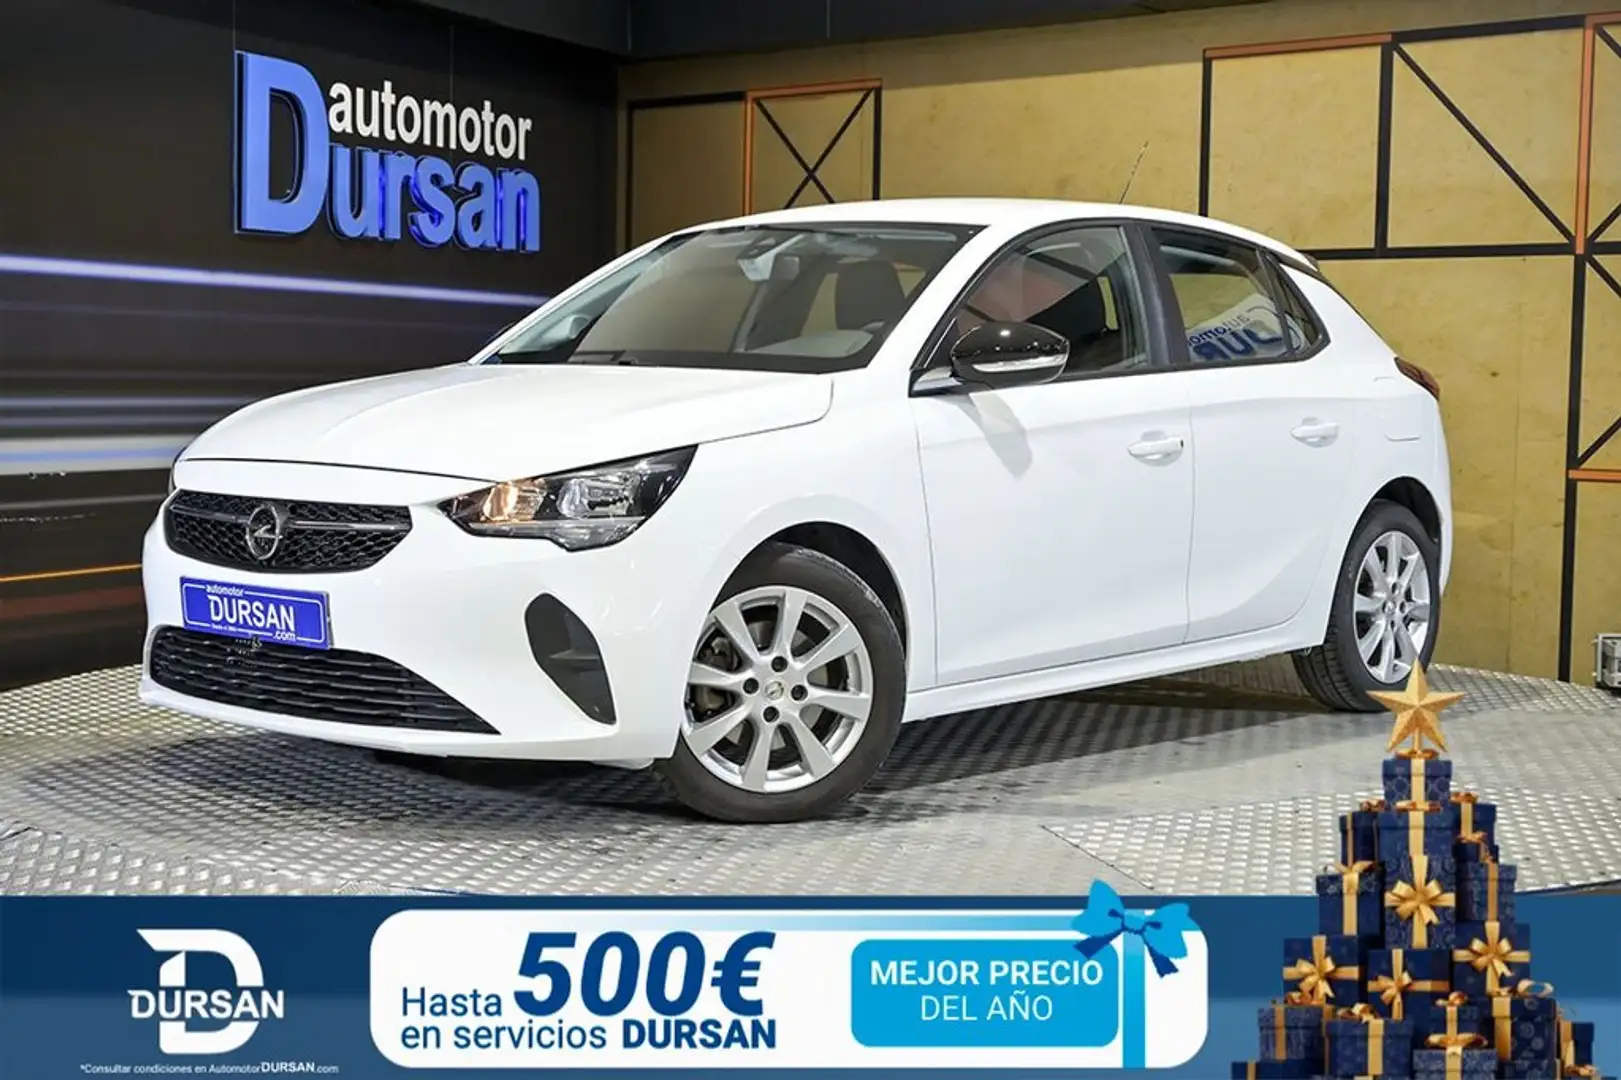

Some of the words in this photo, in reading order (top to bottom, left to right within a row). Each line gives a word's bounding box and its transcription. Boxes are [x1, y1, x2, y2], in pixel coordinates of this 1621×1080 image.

[328, 80, 532, 160] automotor
[234, 50, 540, 253] Dursan
[206, 584, 244, 597] automotor
[207, 595, 295, 631] DURSAN
